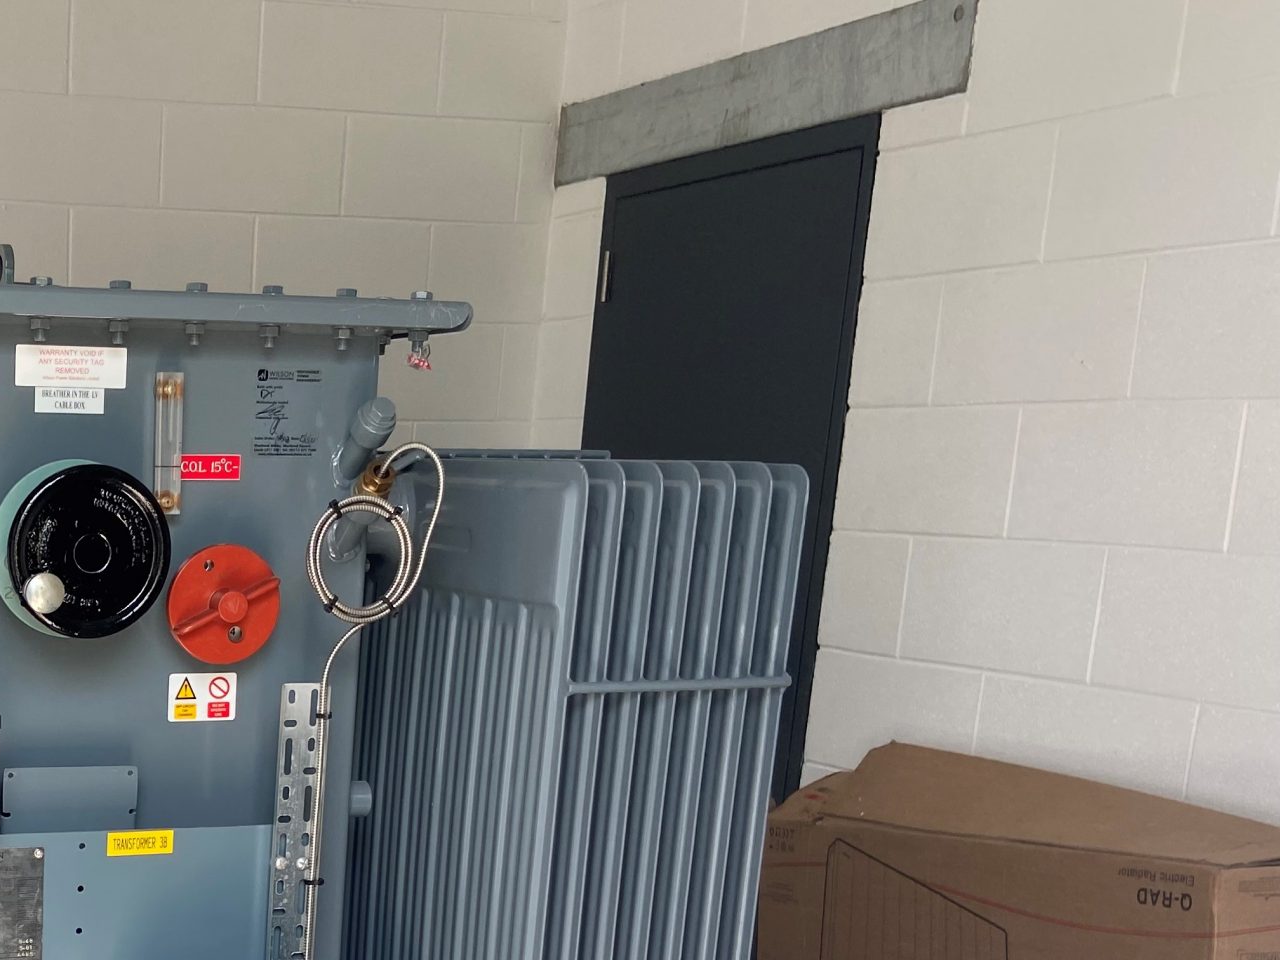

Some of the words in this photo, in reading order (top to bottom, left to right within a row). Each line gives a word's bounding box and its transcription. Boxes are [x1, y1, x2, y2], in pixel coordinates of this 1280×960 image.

[39, 349, 78, 357] WARRANTY
[55, 367, 90, 375] REMOVED
[41, 389, 71, 398] BREATHER
[79, 390, 90, 399] THE
[54, 401, 73, 409] CABLE
[74, 401, 86, 410] BOX
[113, 836, 156, 850] TRANSFORMER
[1136, 887, 1193, 912] Q-RAD
